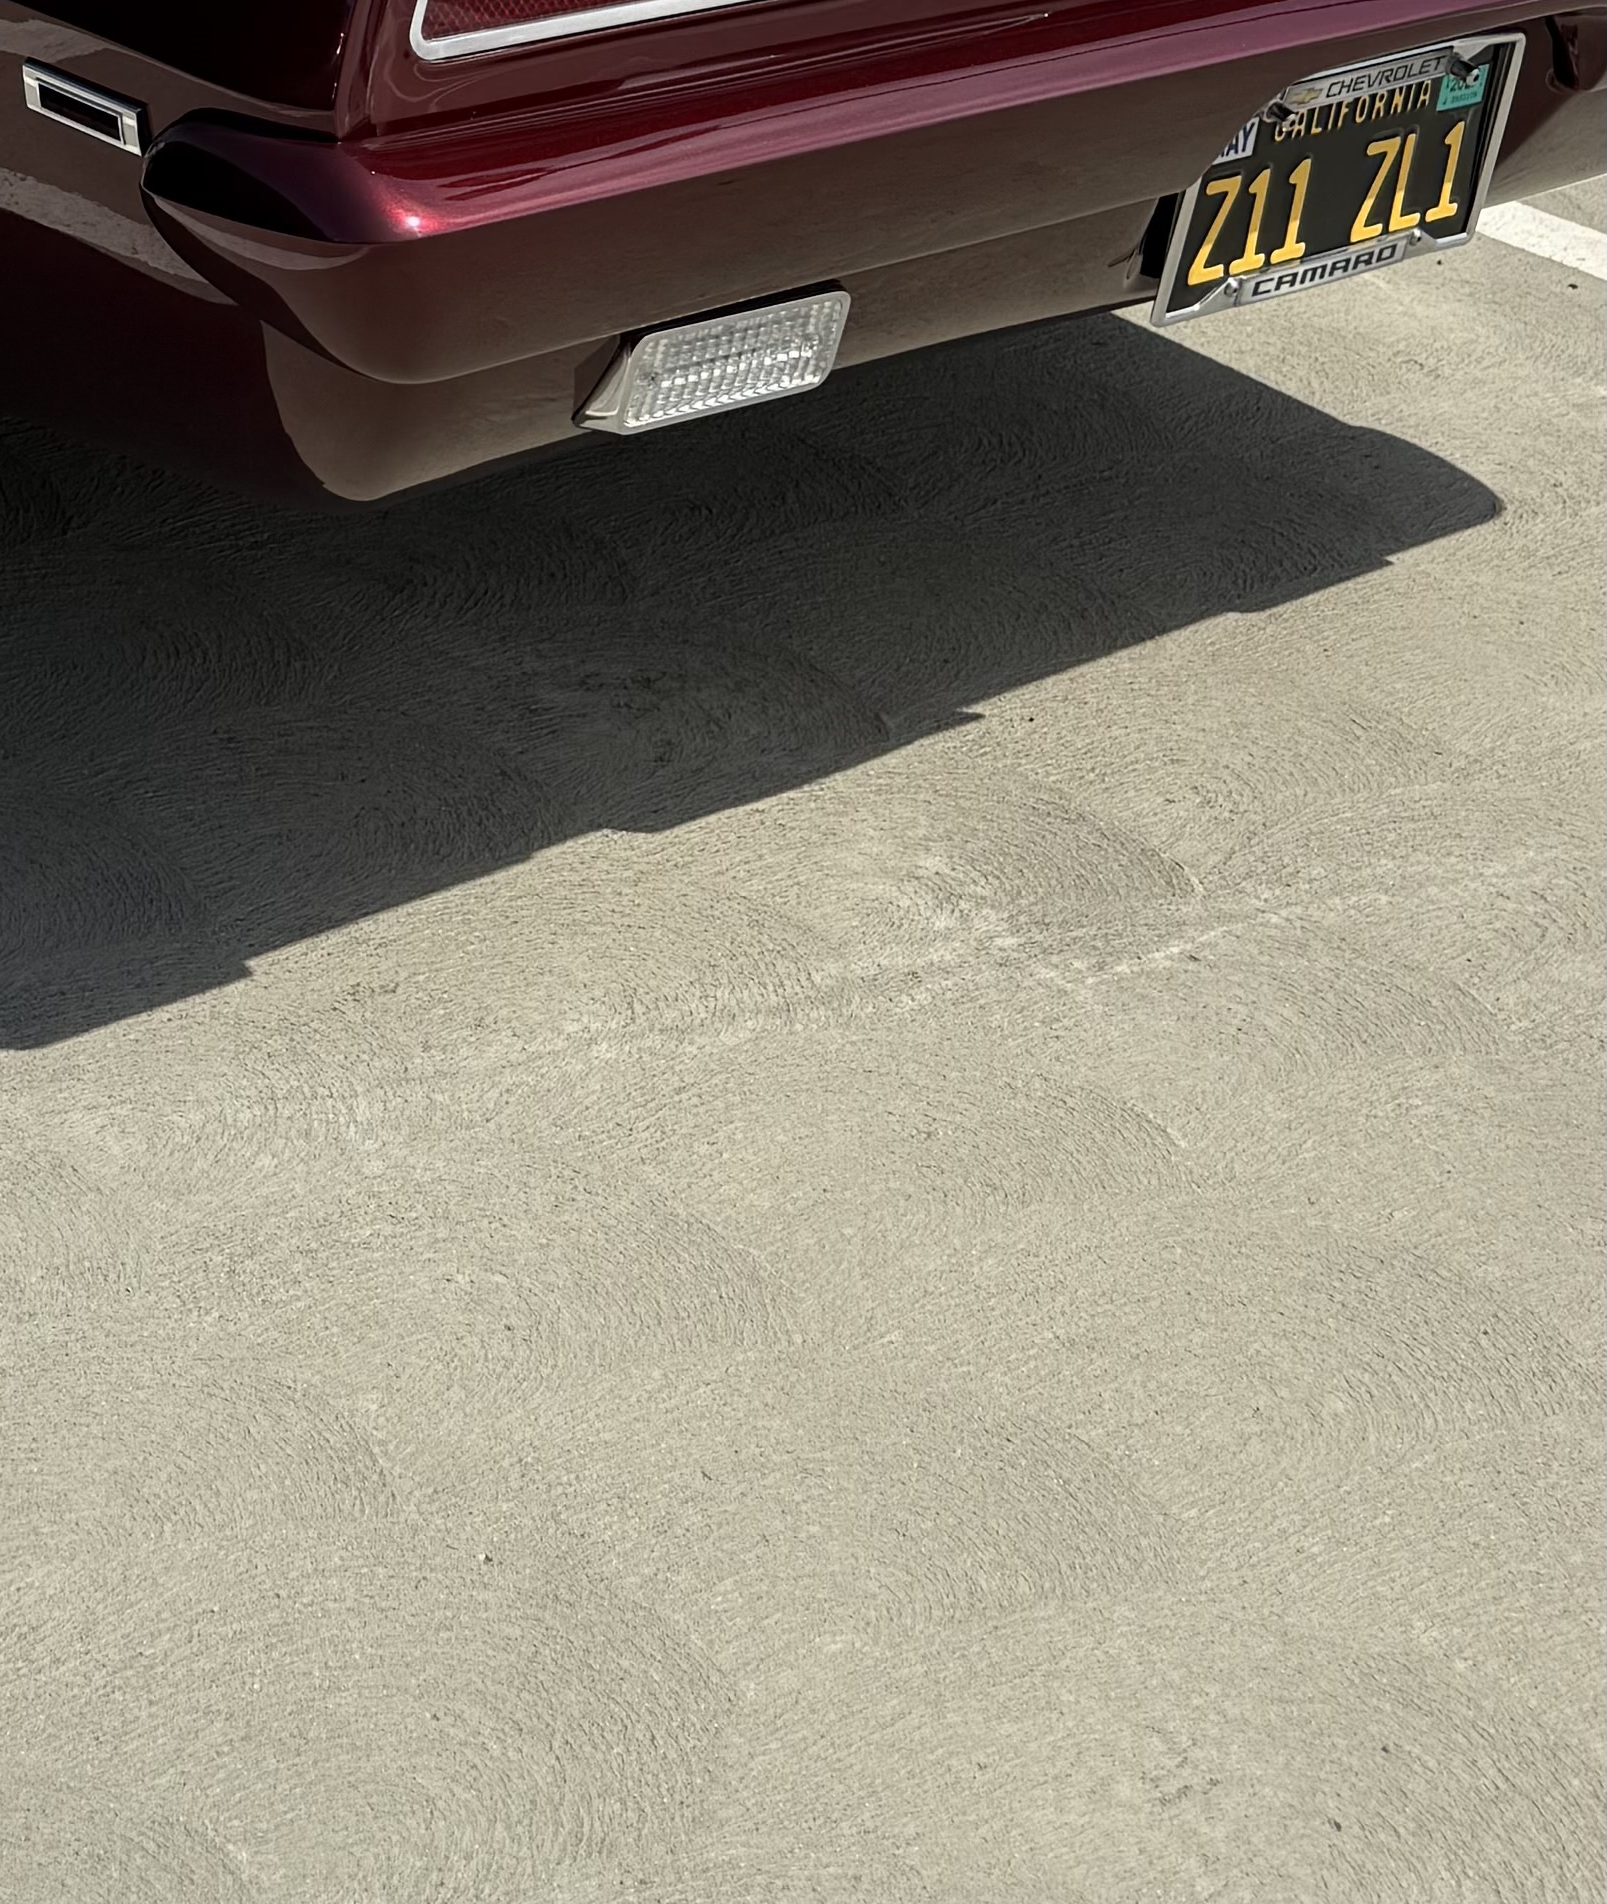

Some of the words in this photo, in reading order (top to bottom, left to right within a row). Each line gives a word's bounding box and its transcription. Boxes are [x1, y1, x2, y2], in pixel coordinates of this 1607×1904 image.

[1325, 54, 1447, 99] CHEVROLET
[1220, 122, 1256, 158] AY
[1187, 157, 1312, 287] Z11
[1350, 121, 1466, 243] ZL1
[1251, 246, 1395, 297] CAMARO
